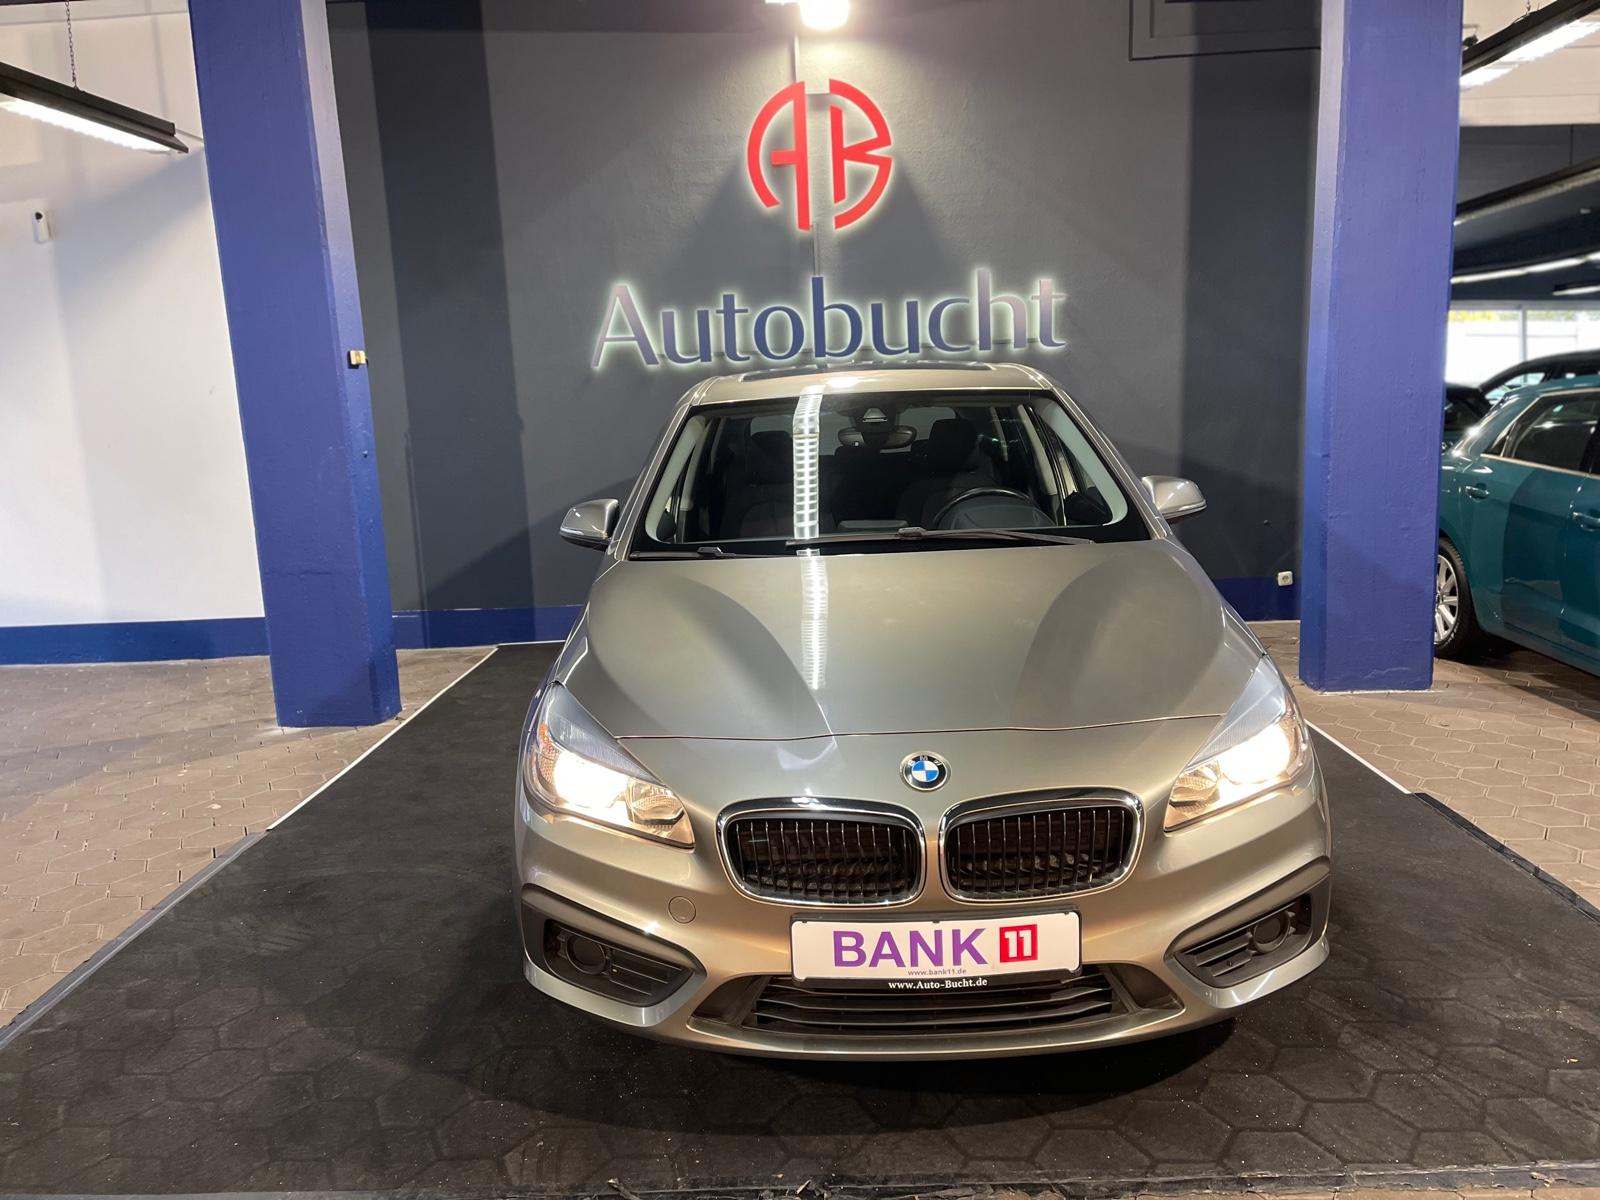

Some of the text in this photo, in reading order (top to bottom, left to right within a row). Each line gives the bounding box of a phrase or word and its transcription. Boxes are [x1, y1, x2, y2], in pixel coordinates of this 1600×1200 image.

[592, 269, 1067, 368] Autobucht
[833, 928, 1032, 968] BANK 11
[888, 978, 988, 990] www.Auto-Bucht.de
[908, 968, 967, 976] www.bank11.de
